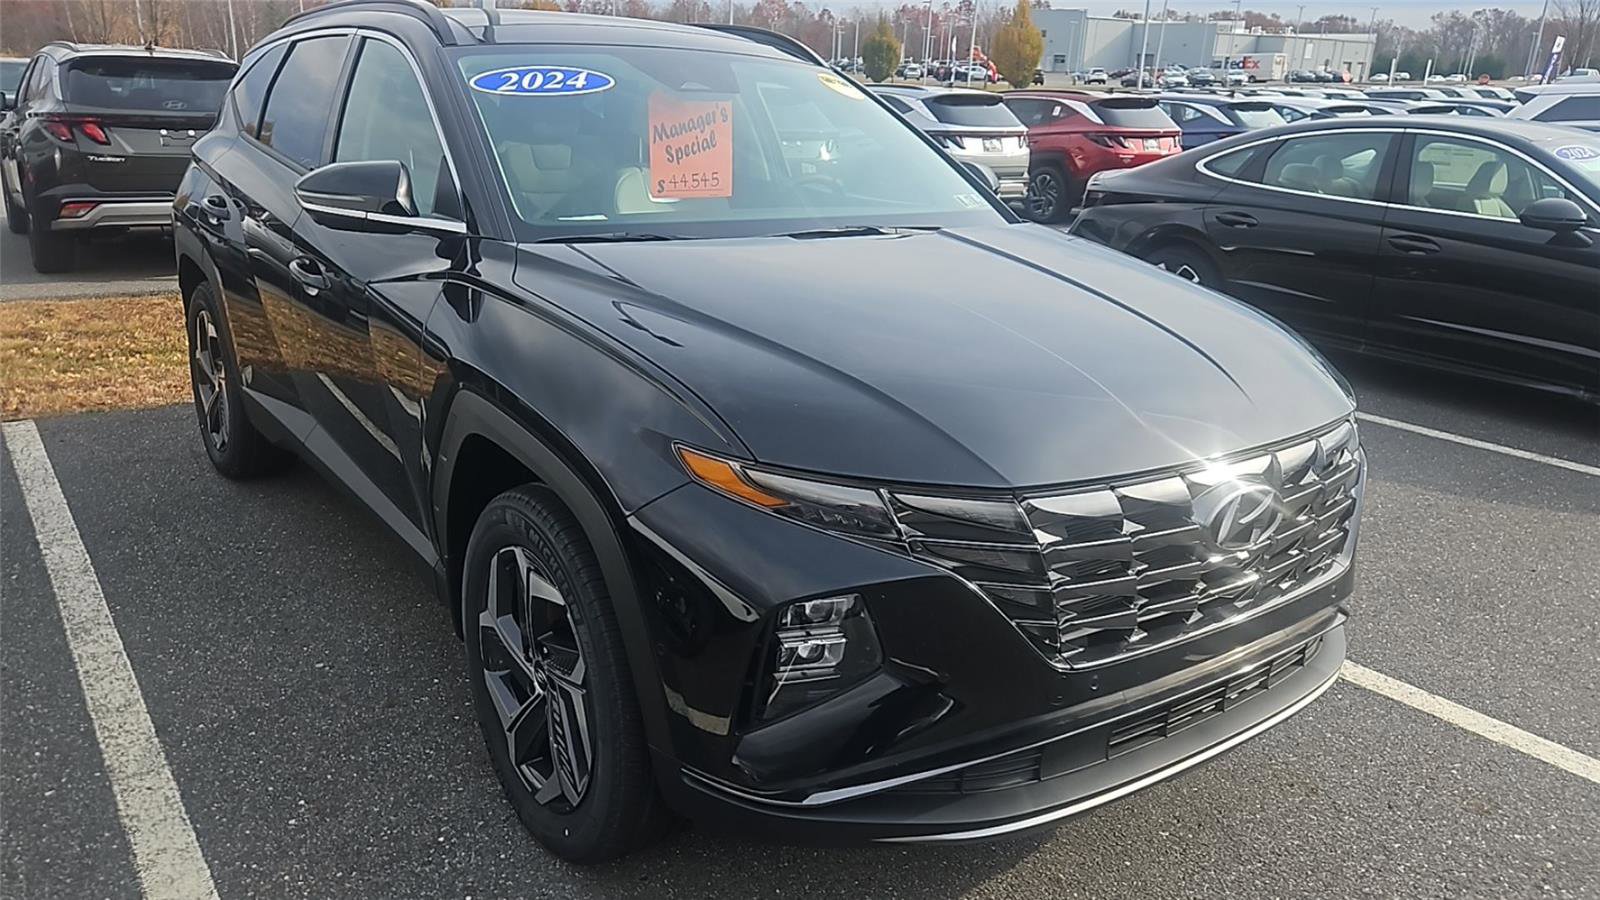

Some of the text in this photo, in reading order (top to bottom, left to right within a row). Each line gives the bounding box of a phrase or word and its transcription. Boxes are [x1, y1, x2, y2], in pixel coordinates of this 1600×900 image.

[1224, 56, 1260, 70] FedEx
[496, 70, 589, 91] 2024
[652, 102, 729, 145] Manager's
[665, 130, 717, 165] Special
[1563, 147, 1595, 160] 2024
